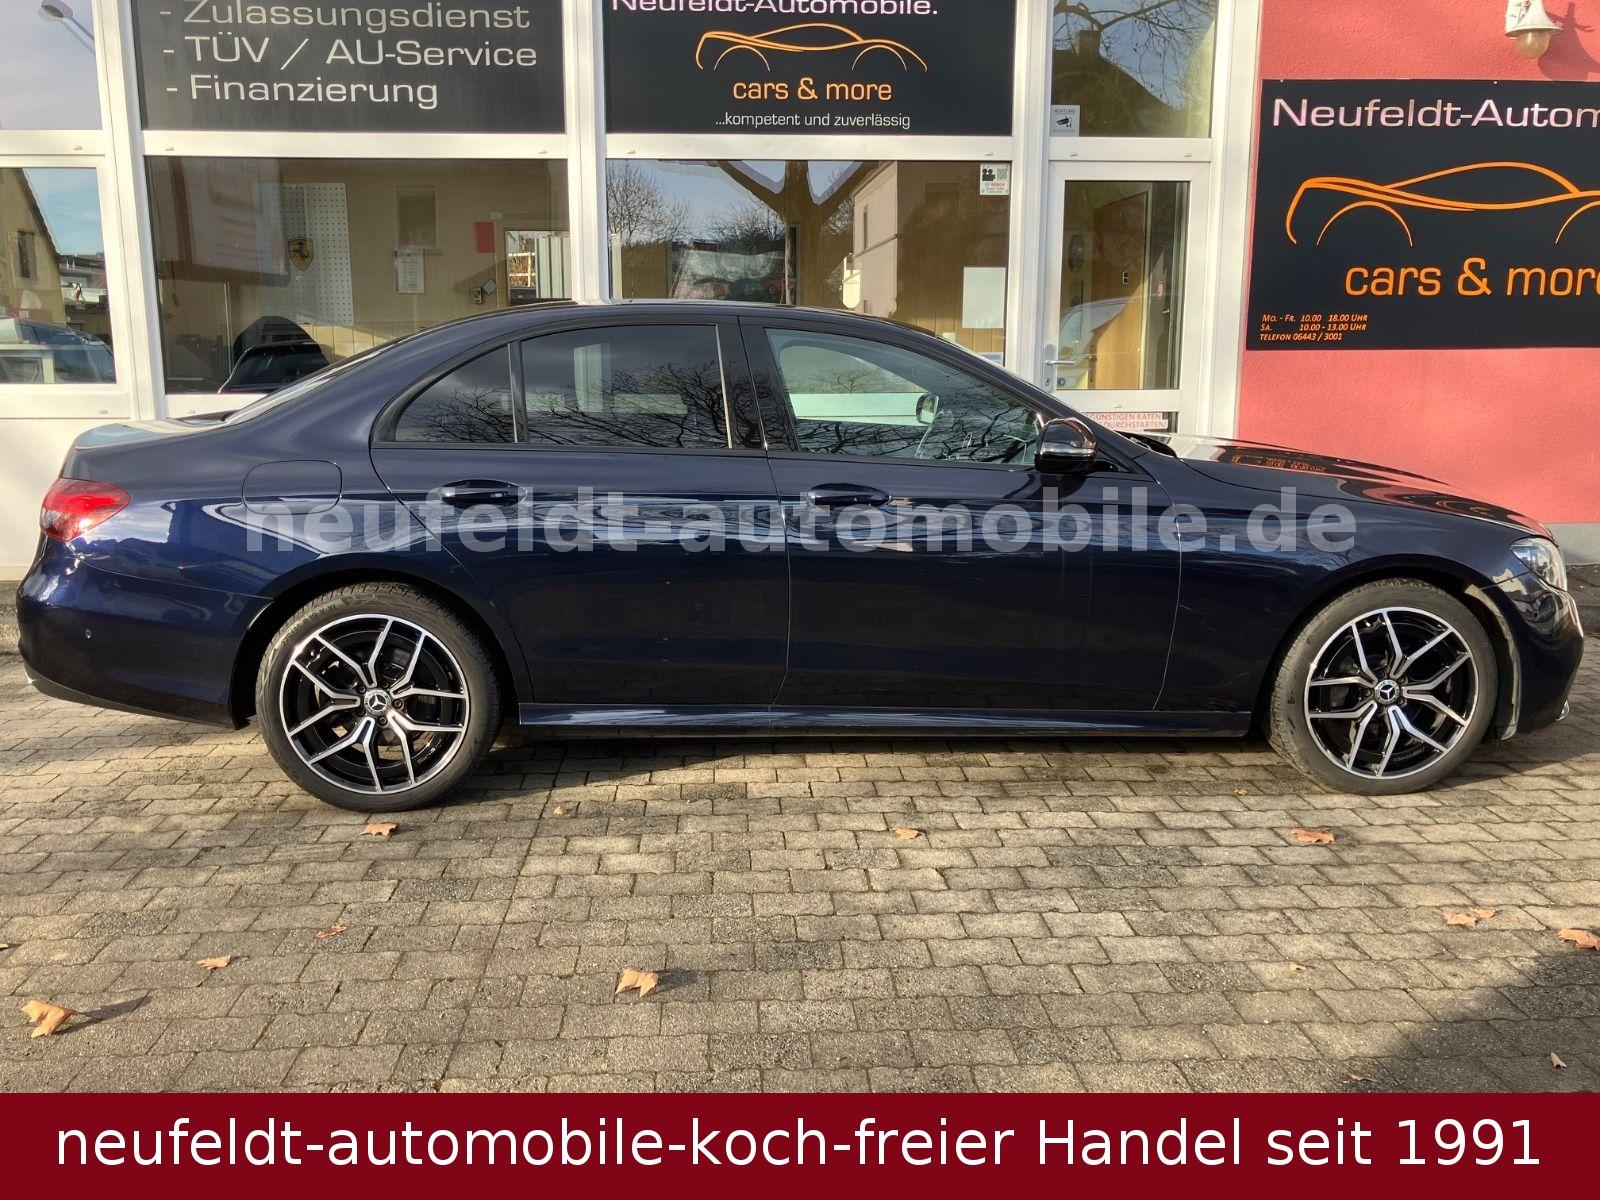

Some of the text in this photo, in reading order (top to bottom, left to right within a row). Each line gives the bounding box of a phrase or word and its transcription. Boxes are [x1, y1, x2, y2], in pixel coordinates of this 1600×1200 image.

[184, 0, 530, 34] Zulassungsdienst
[185, 32, 269, 62] TÜV
[280, 39, 309, 70] /
[326, 39, 537, 66] AU-Service
[190, 74, 437, 110] Finanzierung
[733, 77, 892, 101] cars & more
[804, 113, 830, 126] und
[834, 113, 911, 130] zuverlässig
[1345, 257, 1600, 296] cars & mor
[1299, 323, 1321, 331] 10.00
[1327, 323, 1348, 331] 13.00
[1300, 314, 1322, 322] 10.00
[1328, 314, 1350, 322] 18.00
[1293, 332, 1317, 341] 06443
[1324, 332, 1342, 341] 3001
